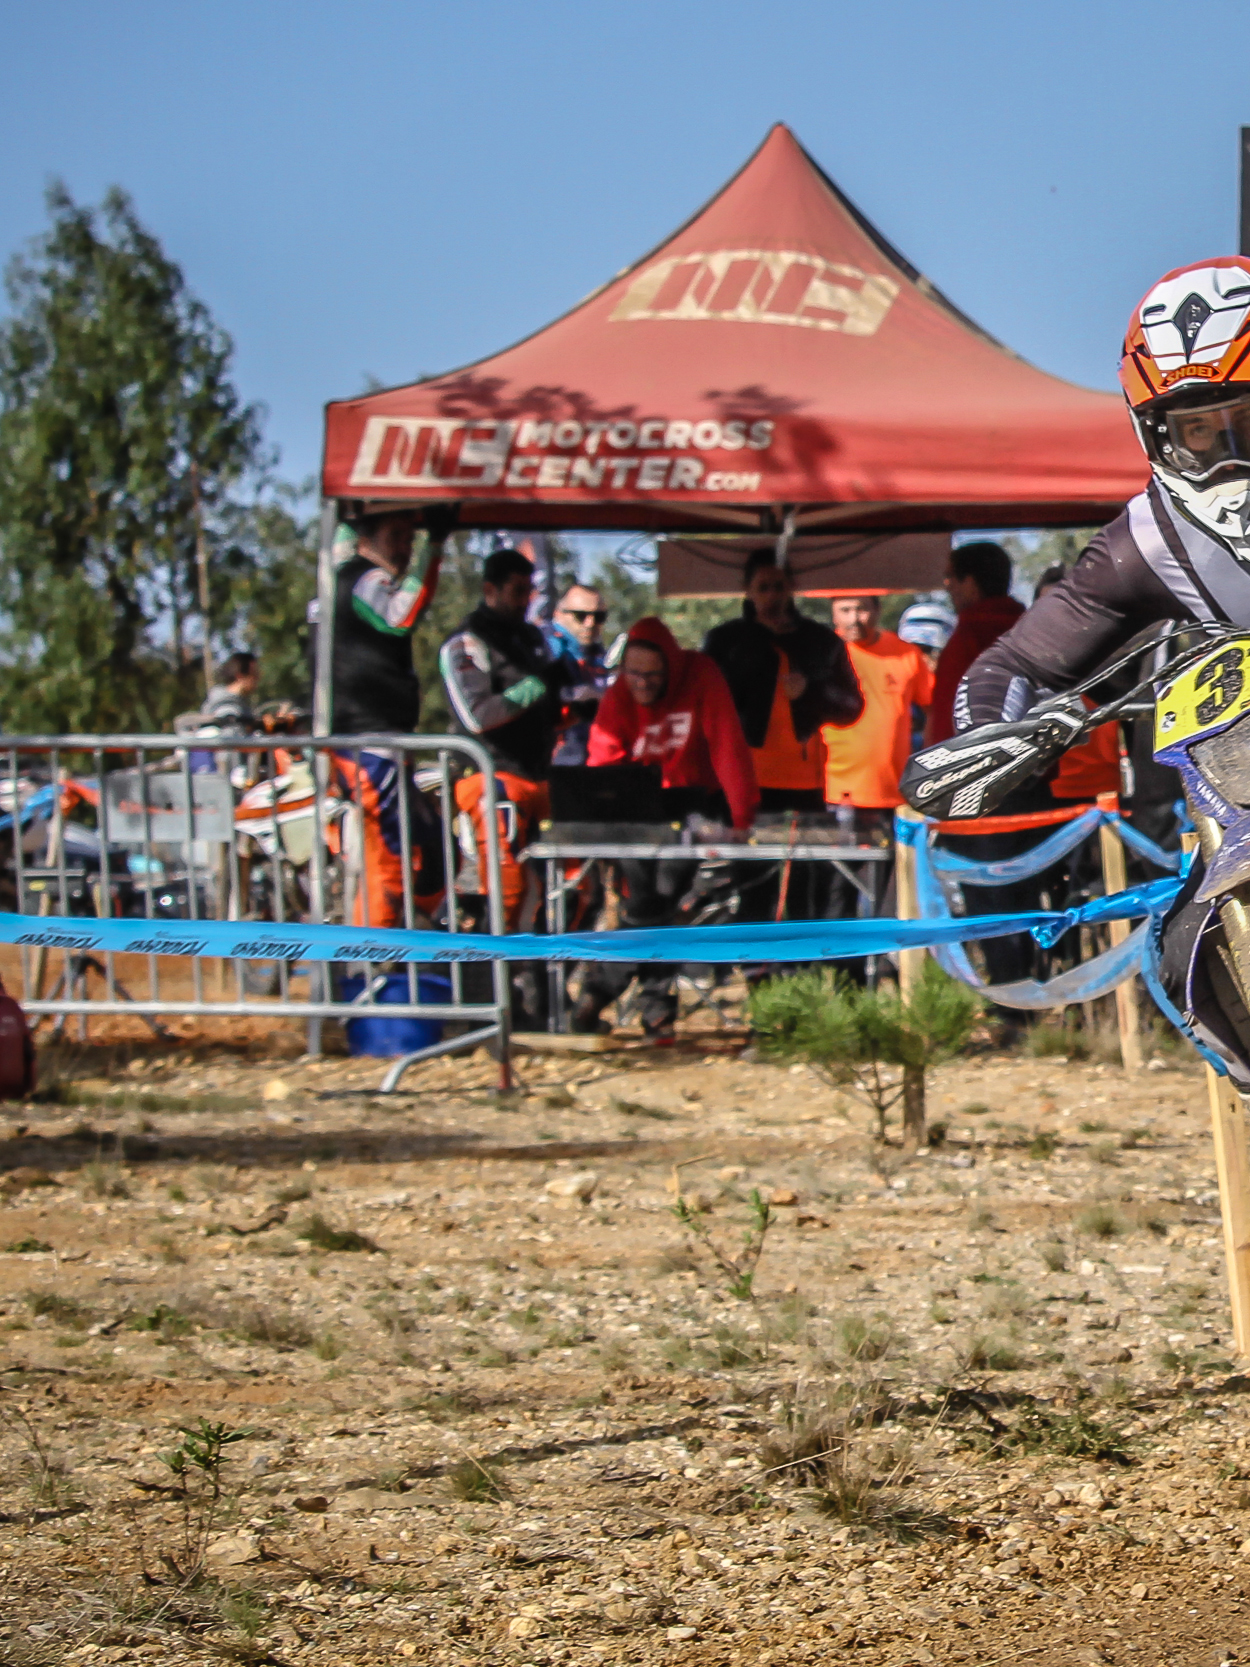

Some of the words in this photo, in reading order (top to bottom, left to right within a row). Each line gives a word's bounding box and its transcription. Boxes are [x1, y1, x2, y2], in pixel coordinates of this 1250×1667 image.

[1166, 365, 1213, 386] SHOEI
[515, 418, 775, 455] MOTOCROSS
[1195, 780, 1228, 817] YAMAHA
